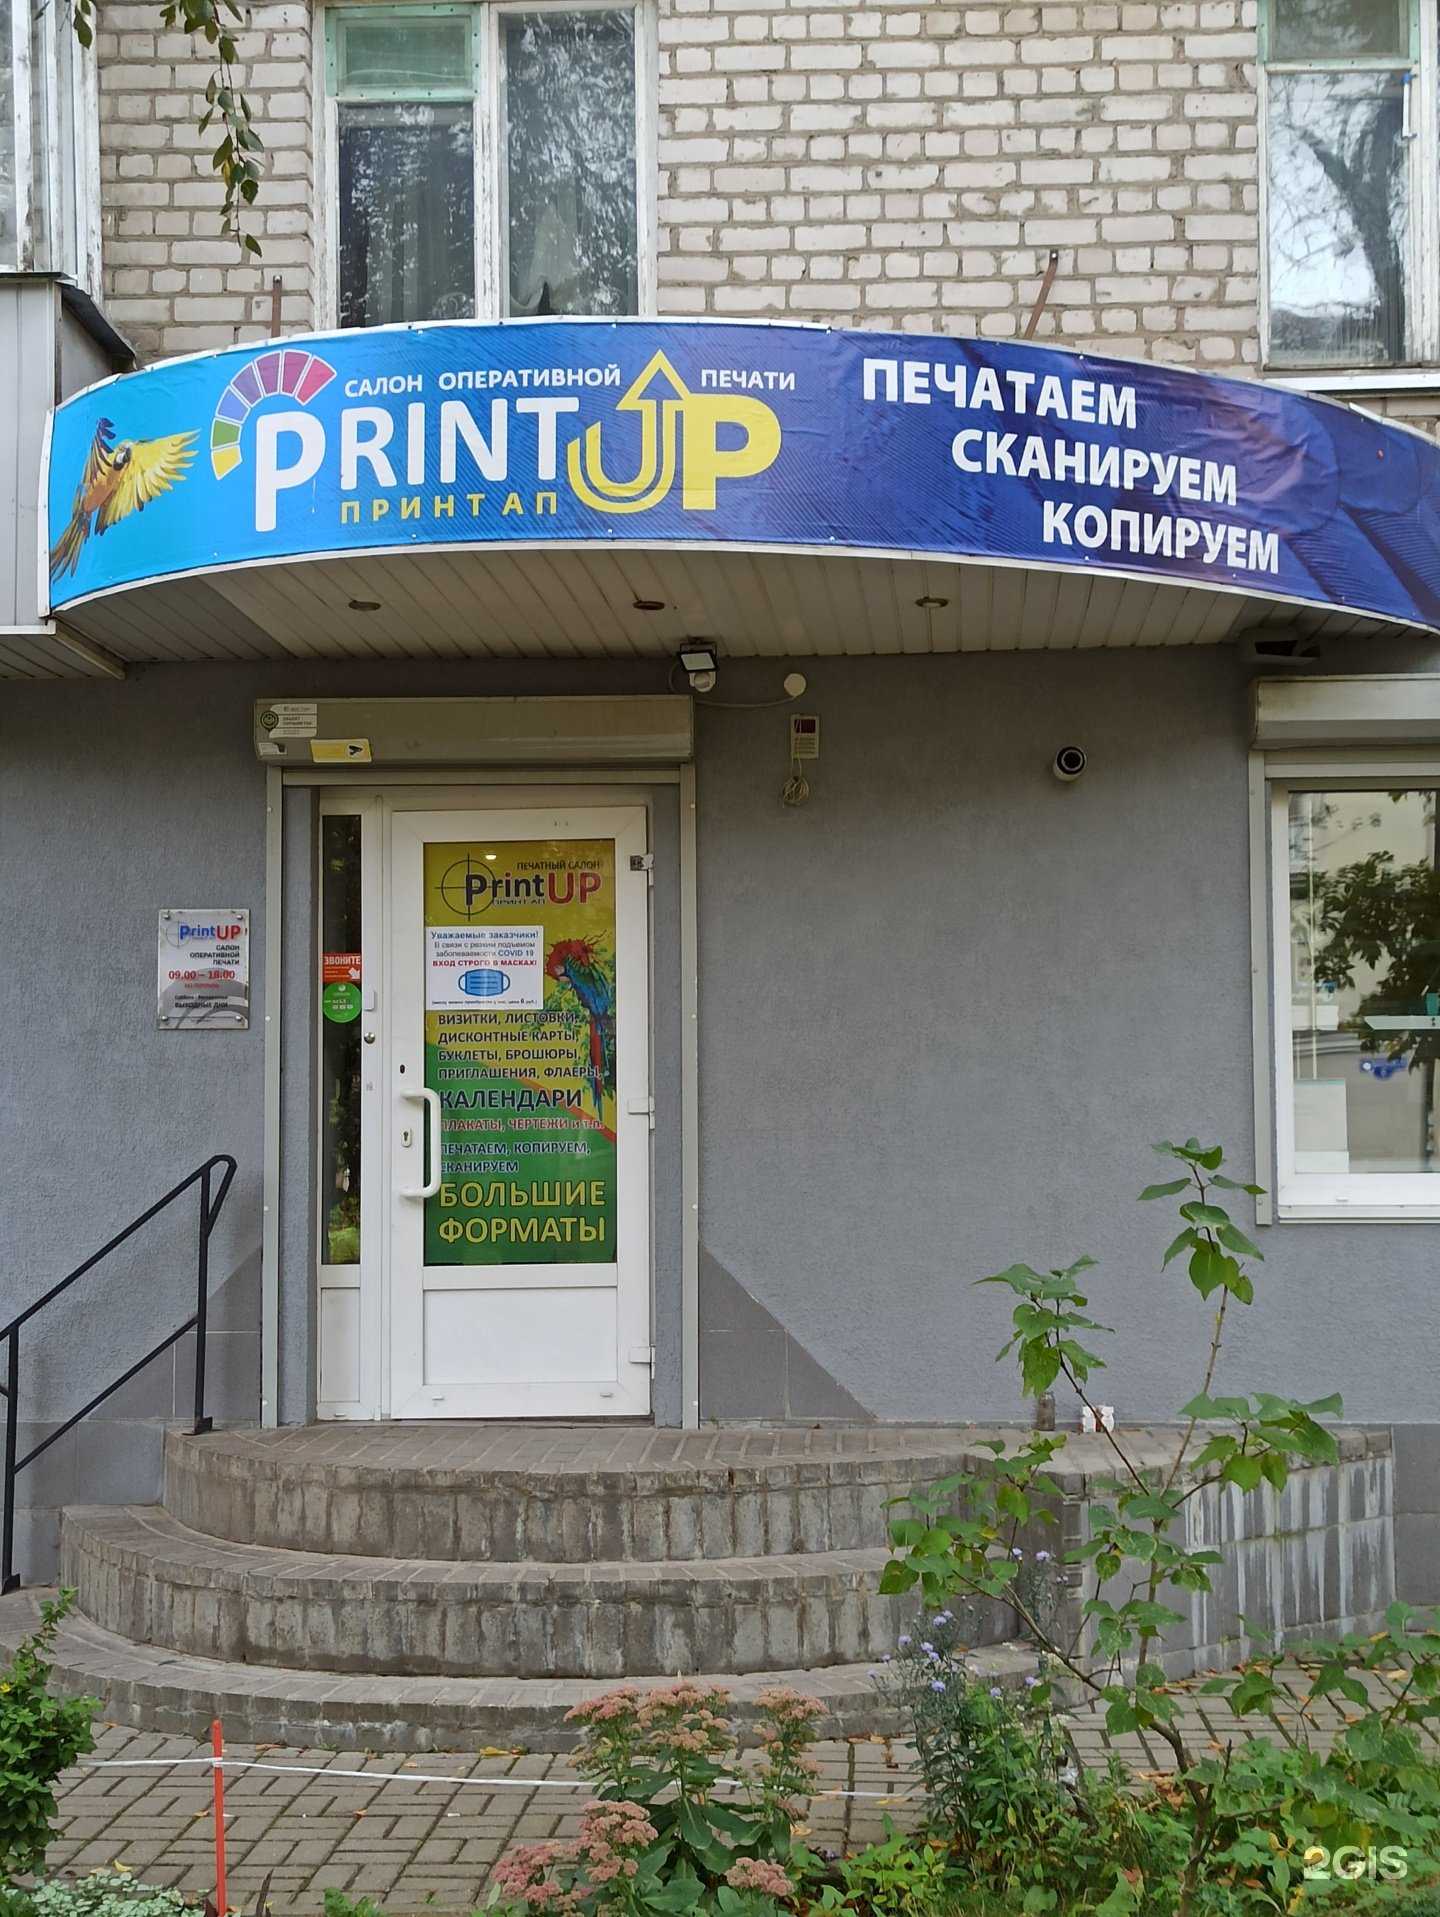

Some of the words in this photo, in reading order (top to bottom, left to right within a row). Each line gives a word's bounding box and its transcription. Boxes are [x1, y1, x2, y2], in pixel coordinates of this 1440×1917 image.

[344, 374, 423, 398] САЛОН
[438, 364, 622, 390] ОПЕРАТИВНОЙ
[700, 368, 797, 390] ПЕЧАТИ
[862, 357, 1138, 430] ПЕЧАТАЕМ
[950, 428, 1238, 507] СКАНИРУЕМ
[1041, 500, 1280, 574] КОПИРУЕМ
[517, 860, 566, 871] ПЕЧАТНЫЙ
[568, 860, 600, 870] САЛОН
[438, 1013, 500, 1025] ВИЗИТКИ,
[505, 1012, 578, 1024] ЛИСТОВКИ,
[438, 1032, 528, 1044] ДИСКОНТНЫЕ
[532, 1030, 579, 1042] КАРТЫ,
[439, 1051, 501, 1061] БУКЛЕТЫ,
[505, 1049, 580, 1060] БРОШЮРЫ,
[439, 1068, 539, 1079] ПРИГЛАШЕНИЯ,
[440, 1089, 582, 1111] КАЛЕНДАРИ
[508, 1119, 568, 1129] ЧЕРТЕЖИ
[514, 1142, 590, 1154] КОПИРУЕМ,
[440, 1181, 606, 1207] БОЛЬШИЕ
[439, 1217, 606, 1243] ФОРМАТЫ
